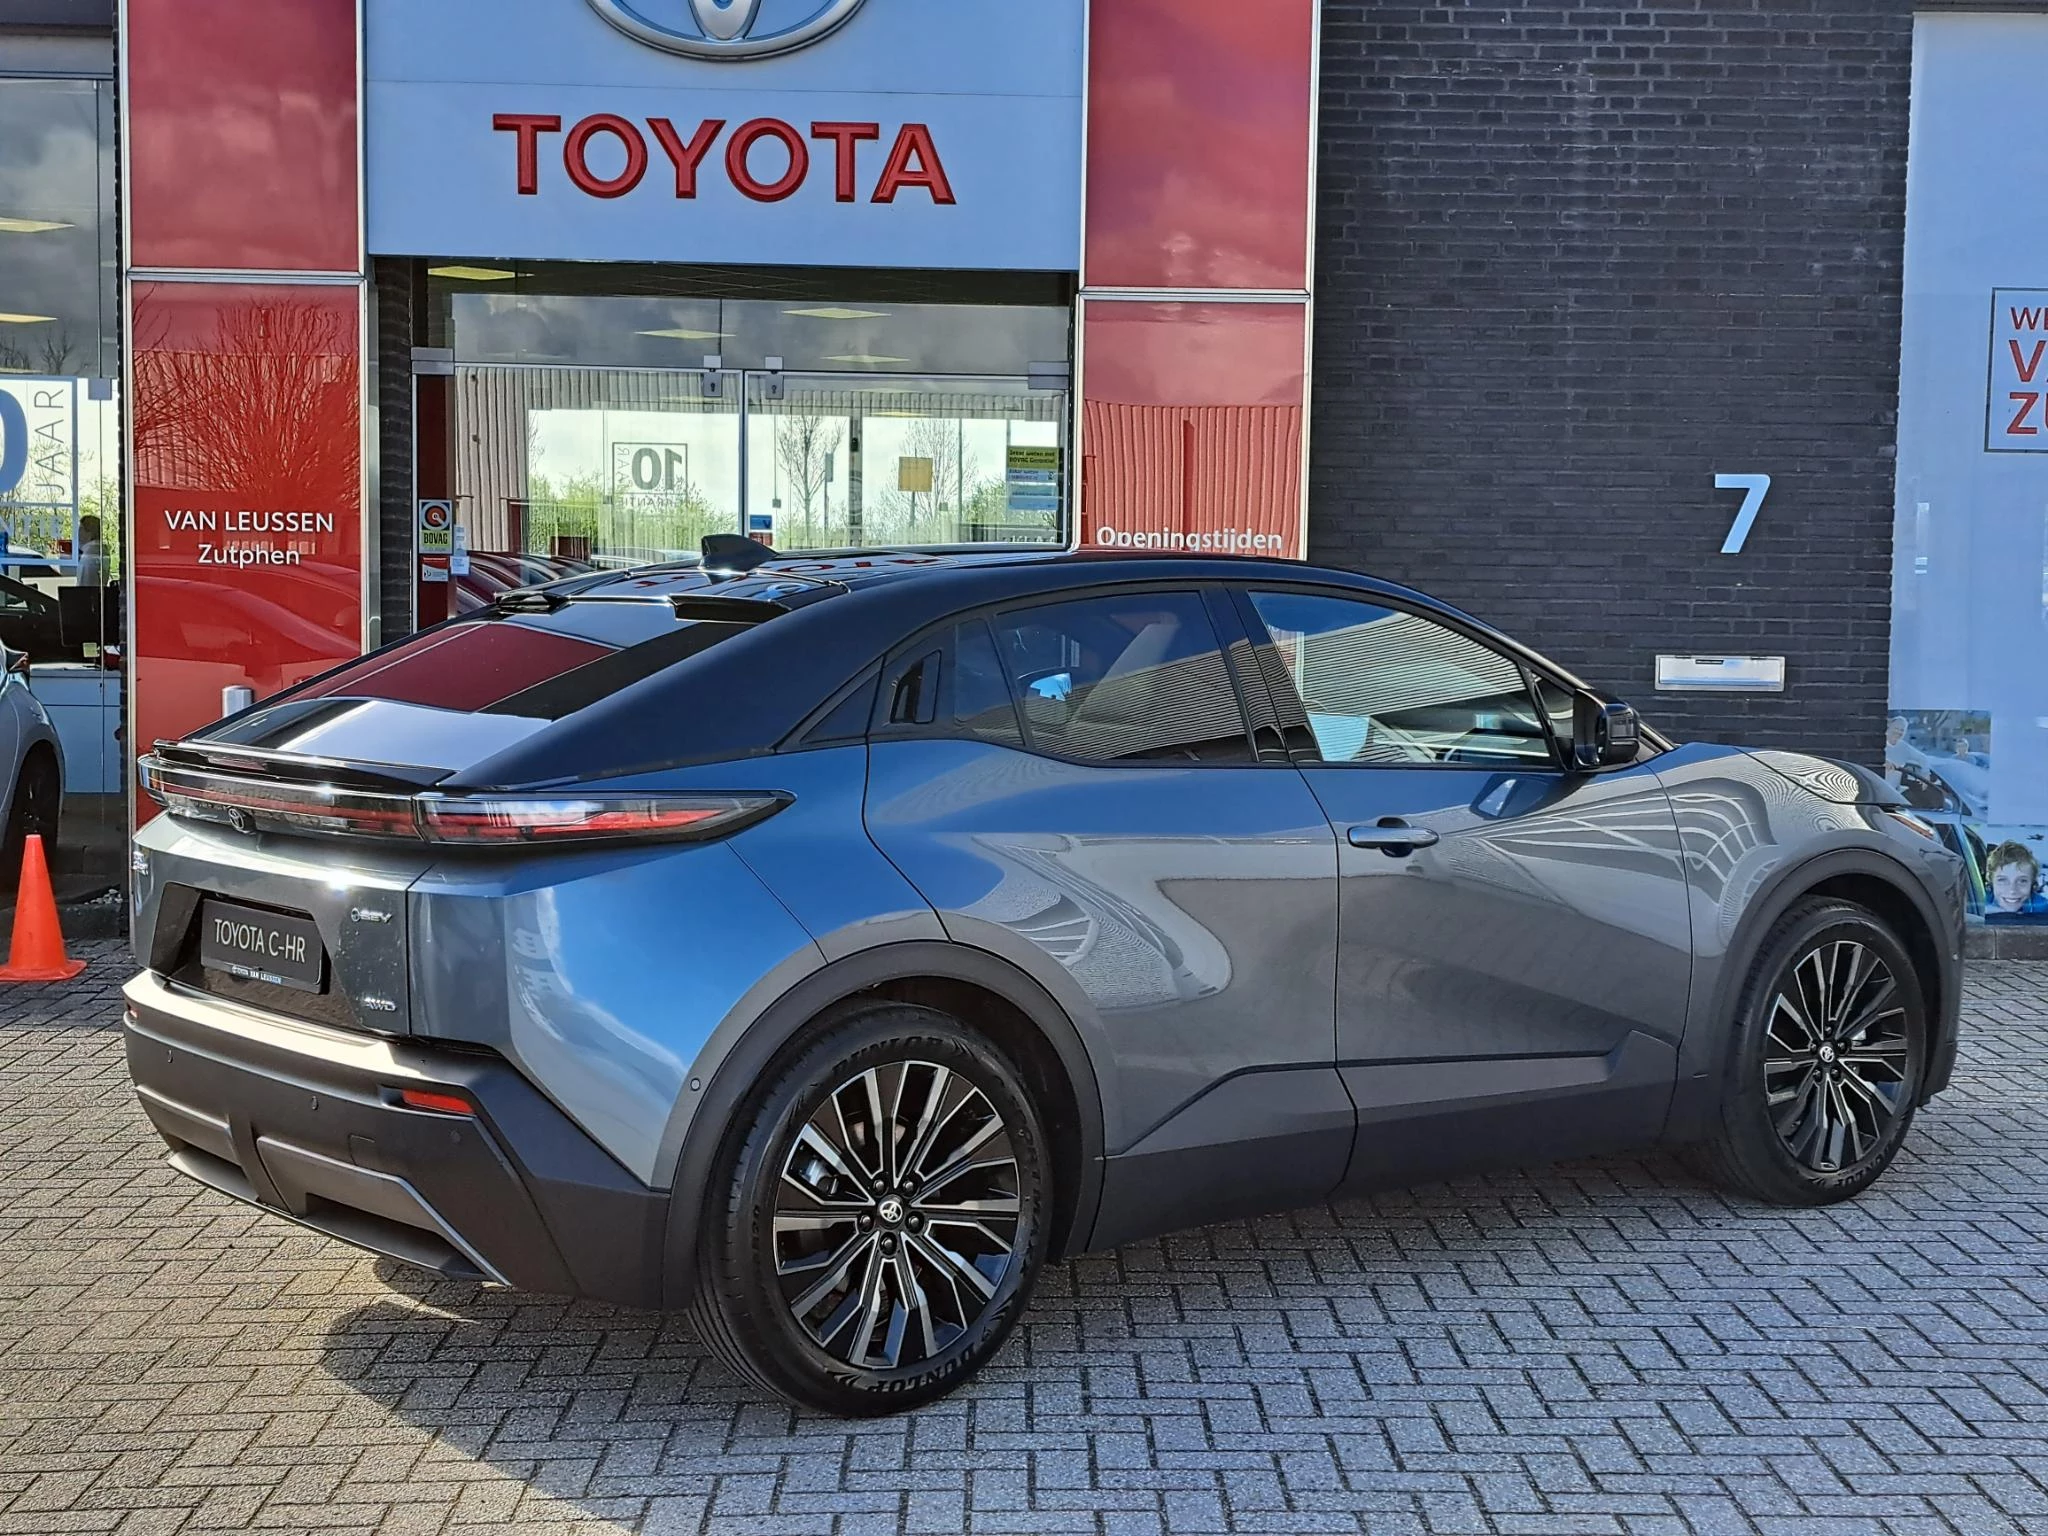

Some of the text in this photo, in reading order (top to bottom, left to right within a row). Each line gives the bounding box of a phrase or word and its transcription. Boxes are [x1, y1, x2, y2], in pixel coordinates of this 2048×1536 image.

[493, 113, 957, 205] TOYOTA
[2009, 339, 2048, 382] V
[2007, 391, 2048, 434] Z
[34, 389, 64, 496] JAAR
[165, 510, 334, 532] VAN LEUSSEN
[1715, 474, 1771, 553] 7
[198, 544, 300, 570] Zutphen
[1096, 526, 1283, 553] Openingstijden
[214, 918, 306, 963] TOYOTA C-HR
[868, 1341, 977, 1393] DUNLOP
